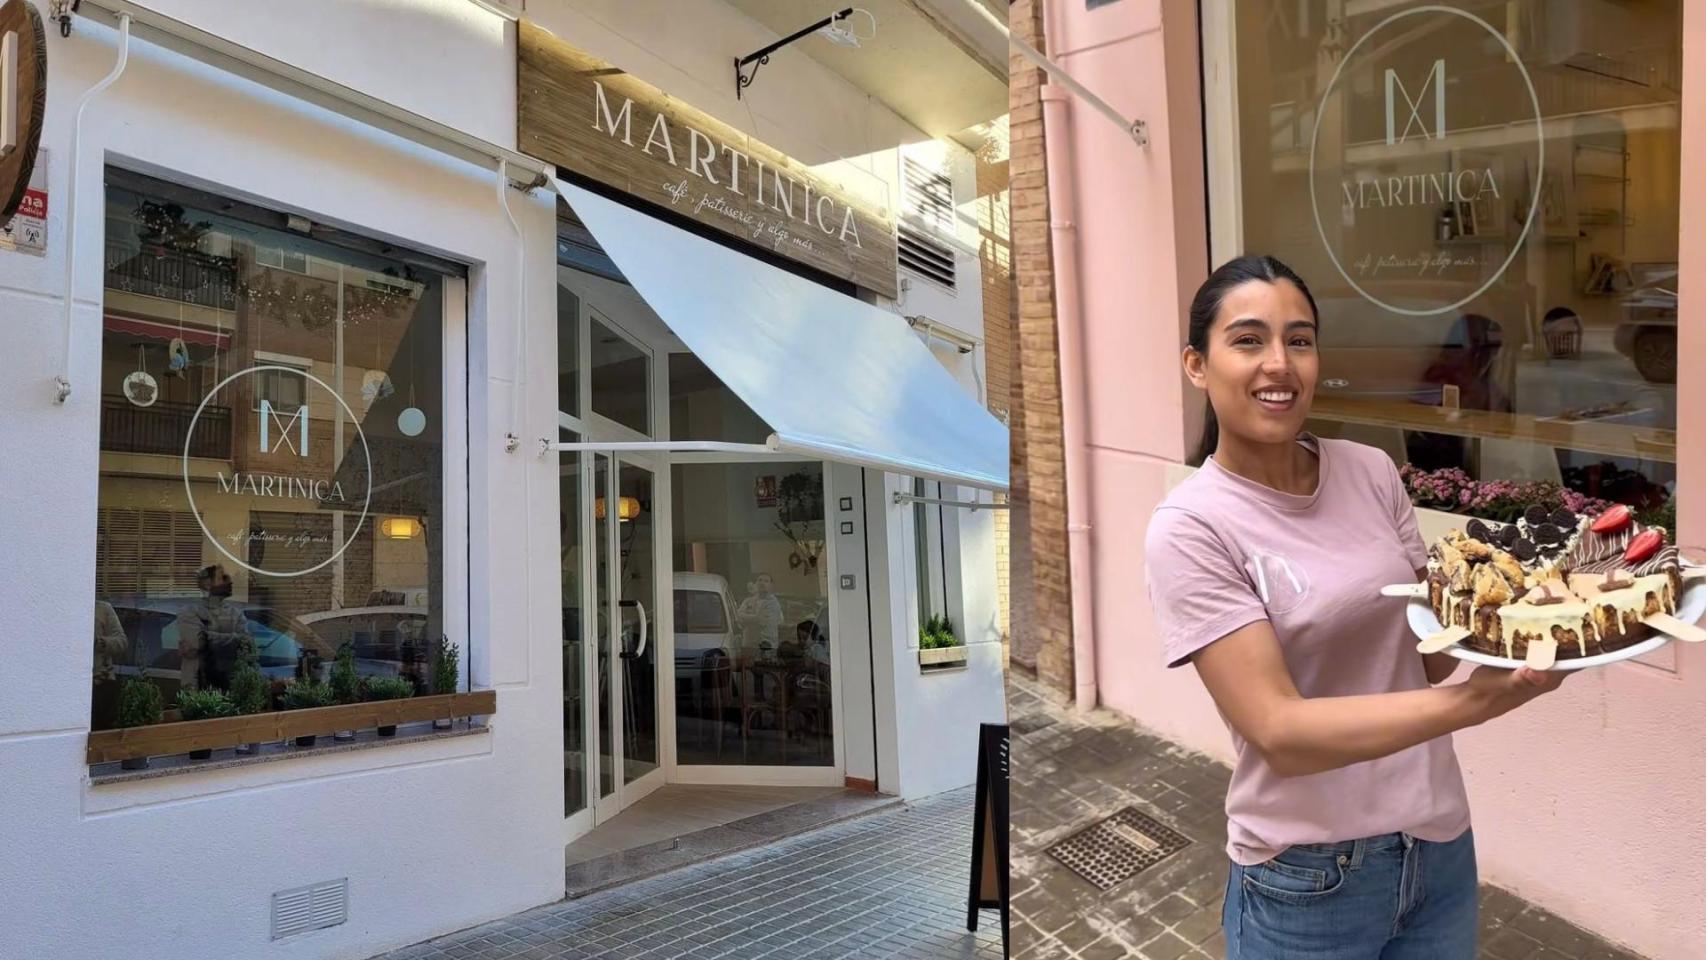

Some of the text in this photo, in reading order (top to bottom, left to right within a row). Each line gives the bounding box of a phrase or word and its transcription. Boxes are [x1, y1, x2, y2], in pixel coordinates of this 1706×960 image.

[591, 80, 863, 249] MARTINICA
[1341, 167, 1500, 209] MARTINICA
[694, 193, 753, 224] patisserie
[753, 217, 767, 238] y
[767, 221, 789, 246] algo
[216, 471, 345, 502] MARTINICA
